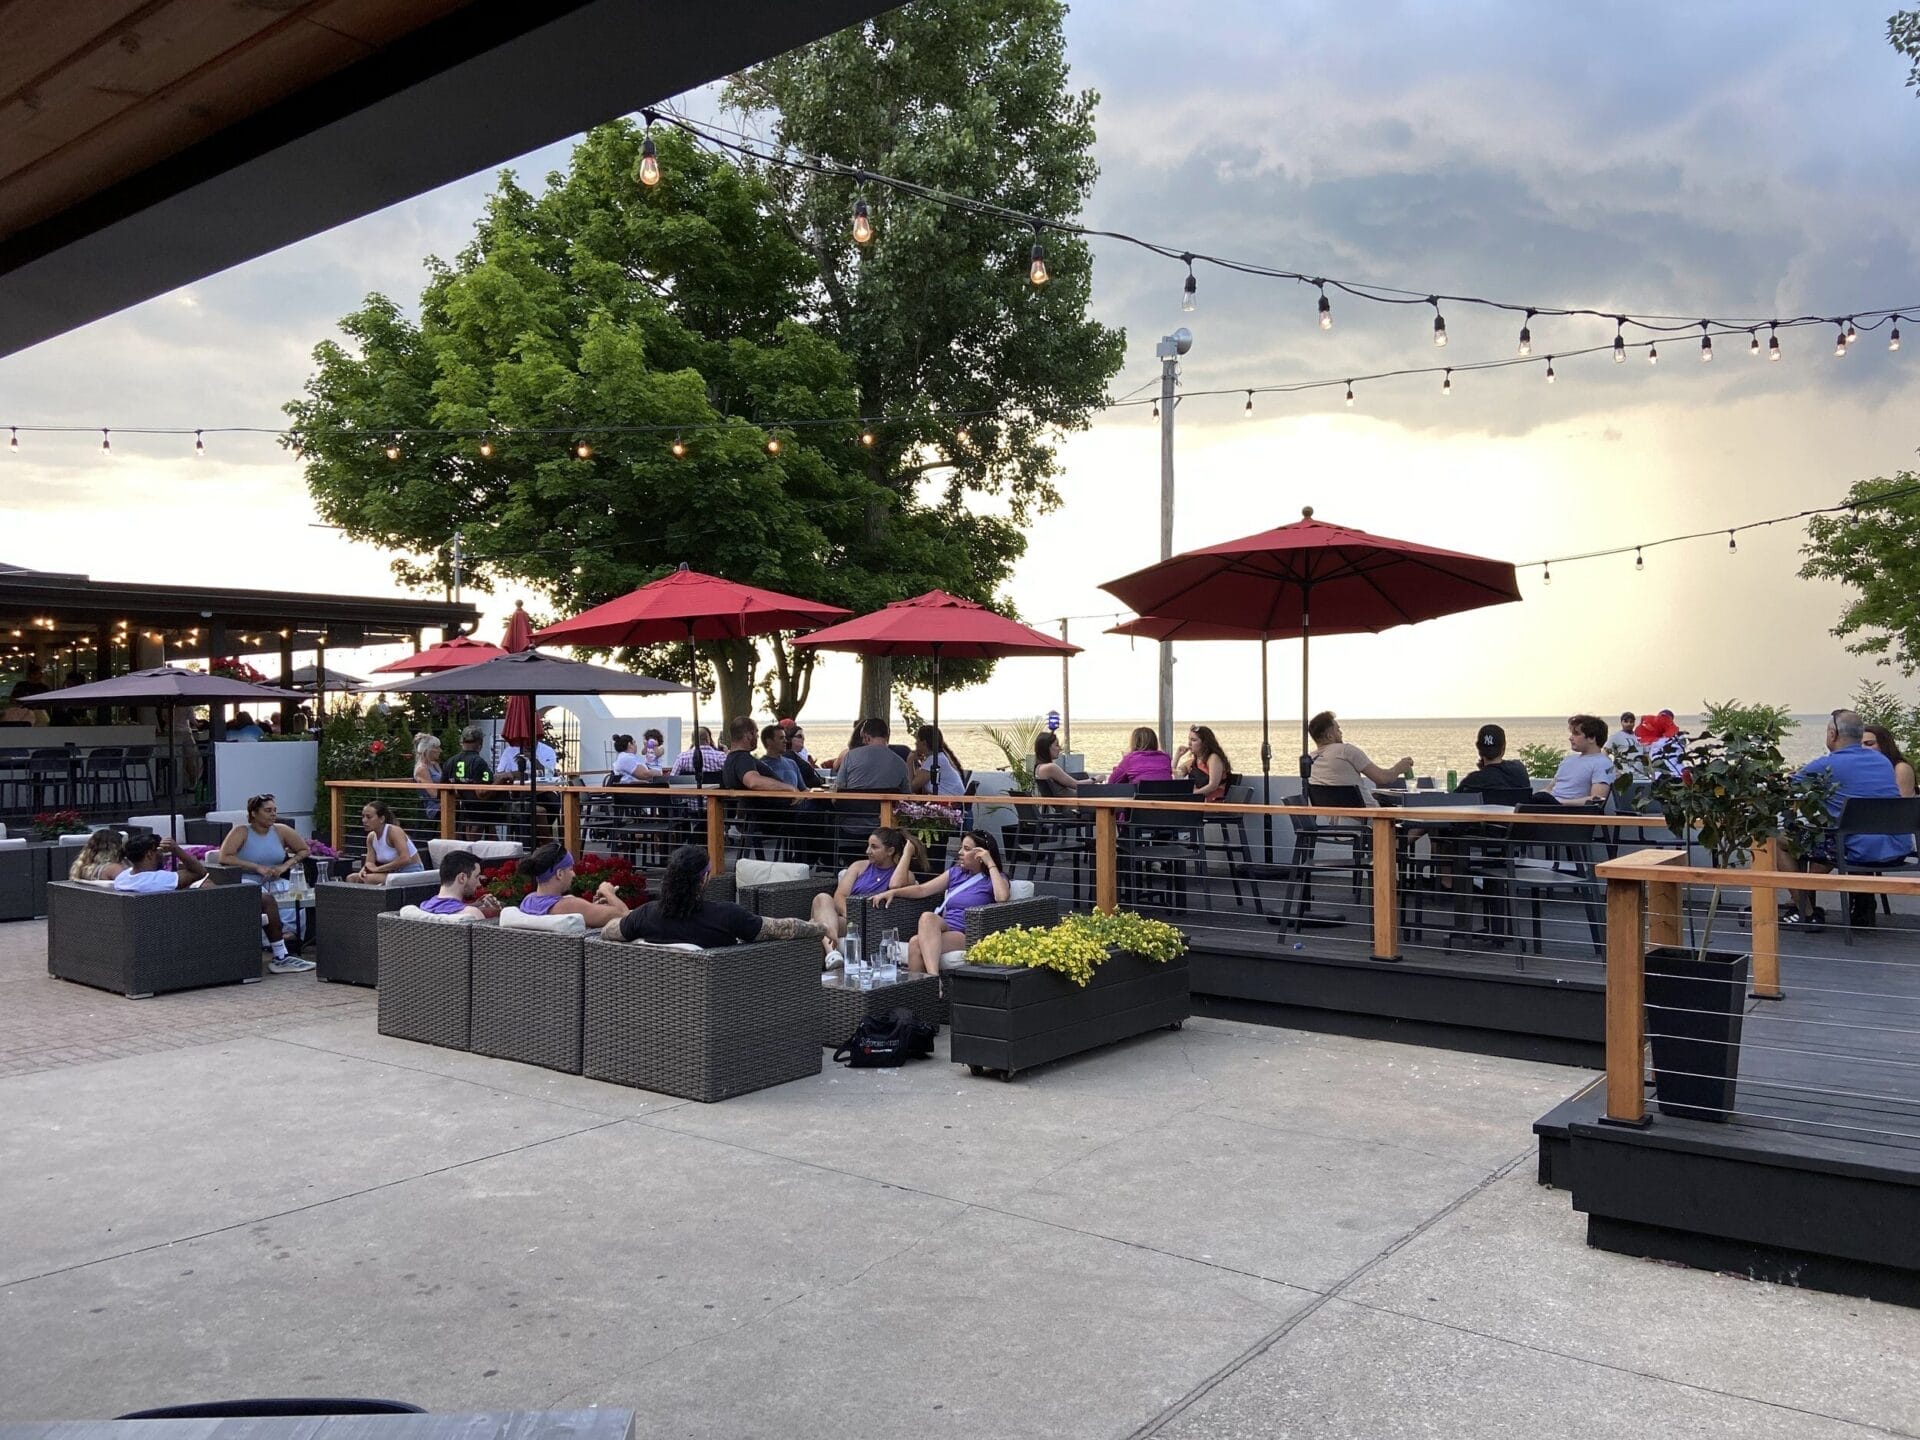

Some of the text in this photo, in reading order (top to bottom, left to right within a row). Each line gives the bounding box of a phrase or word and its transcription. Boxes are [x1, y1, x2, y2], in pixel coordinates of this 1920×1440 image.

[1484, 734, 1494, 745] NY
[455, 761, 465, 778] 3
[481, 771, 490, 782] 3
